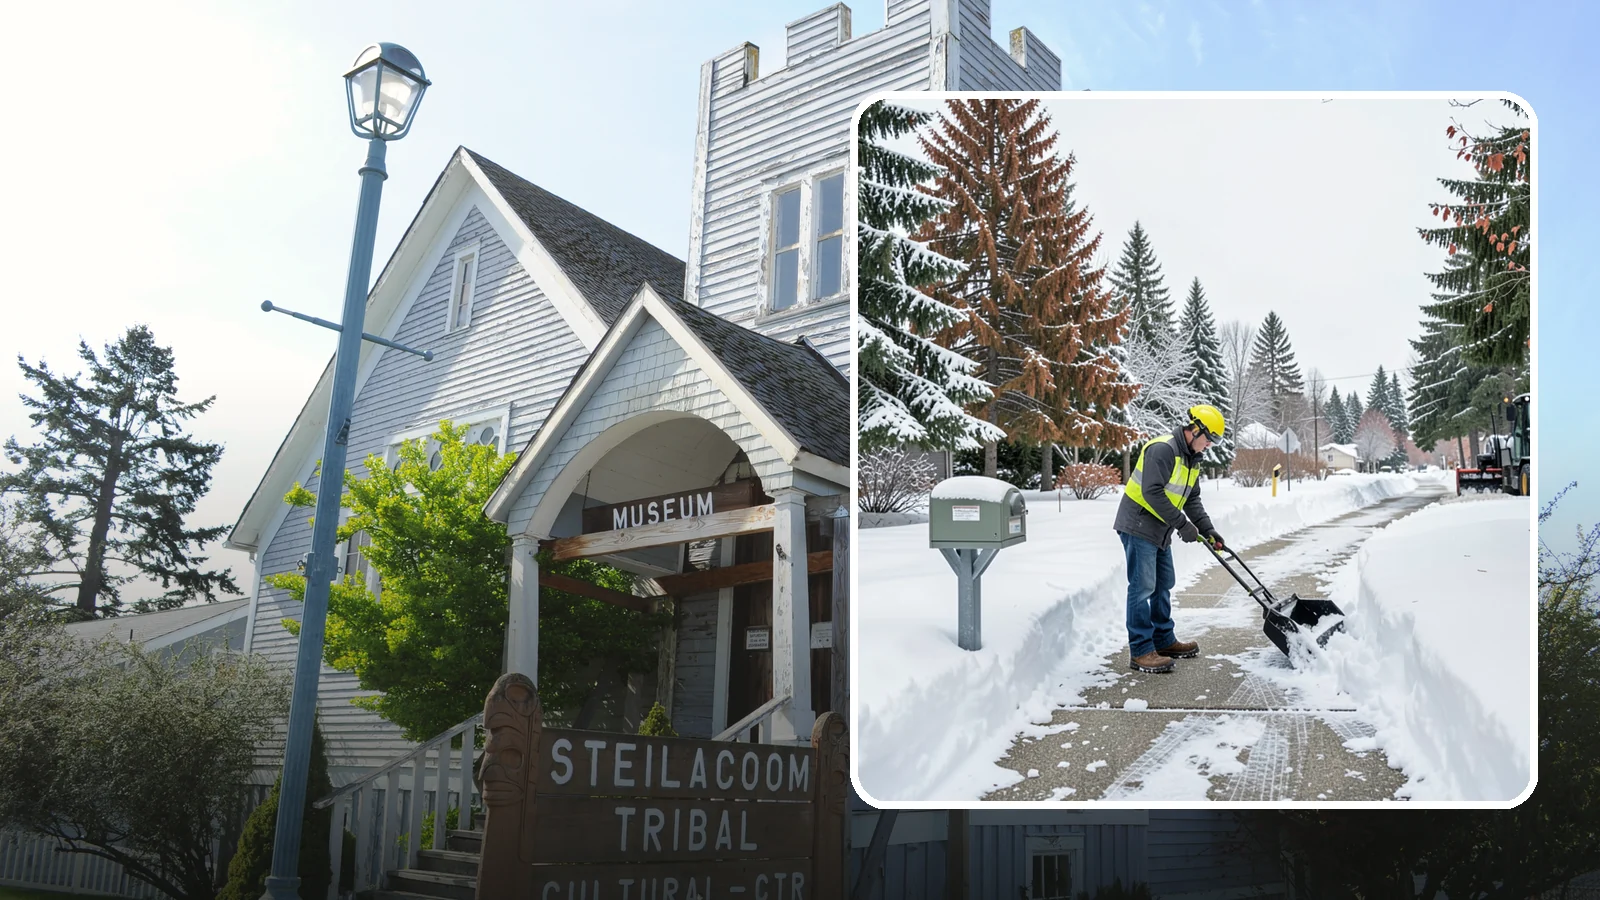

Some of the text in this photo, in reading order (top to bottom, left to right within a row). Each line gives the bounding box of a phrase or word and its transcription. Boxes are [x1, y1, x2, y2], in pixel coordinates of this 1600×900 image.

[613, 491, 713, 530] MUSEUM
[551, 738, 809, 792] STEILACOOM
[615, 807, 757, 851] TRIBAL
